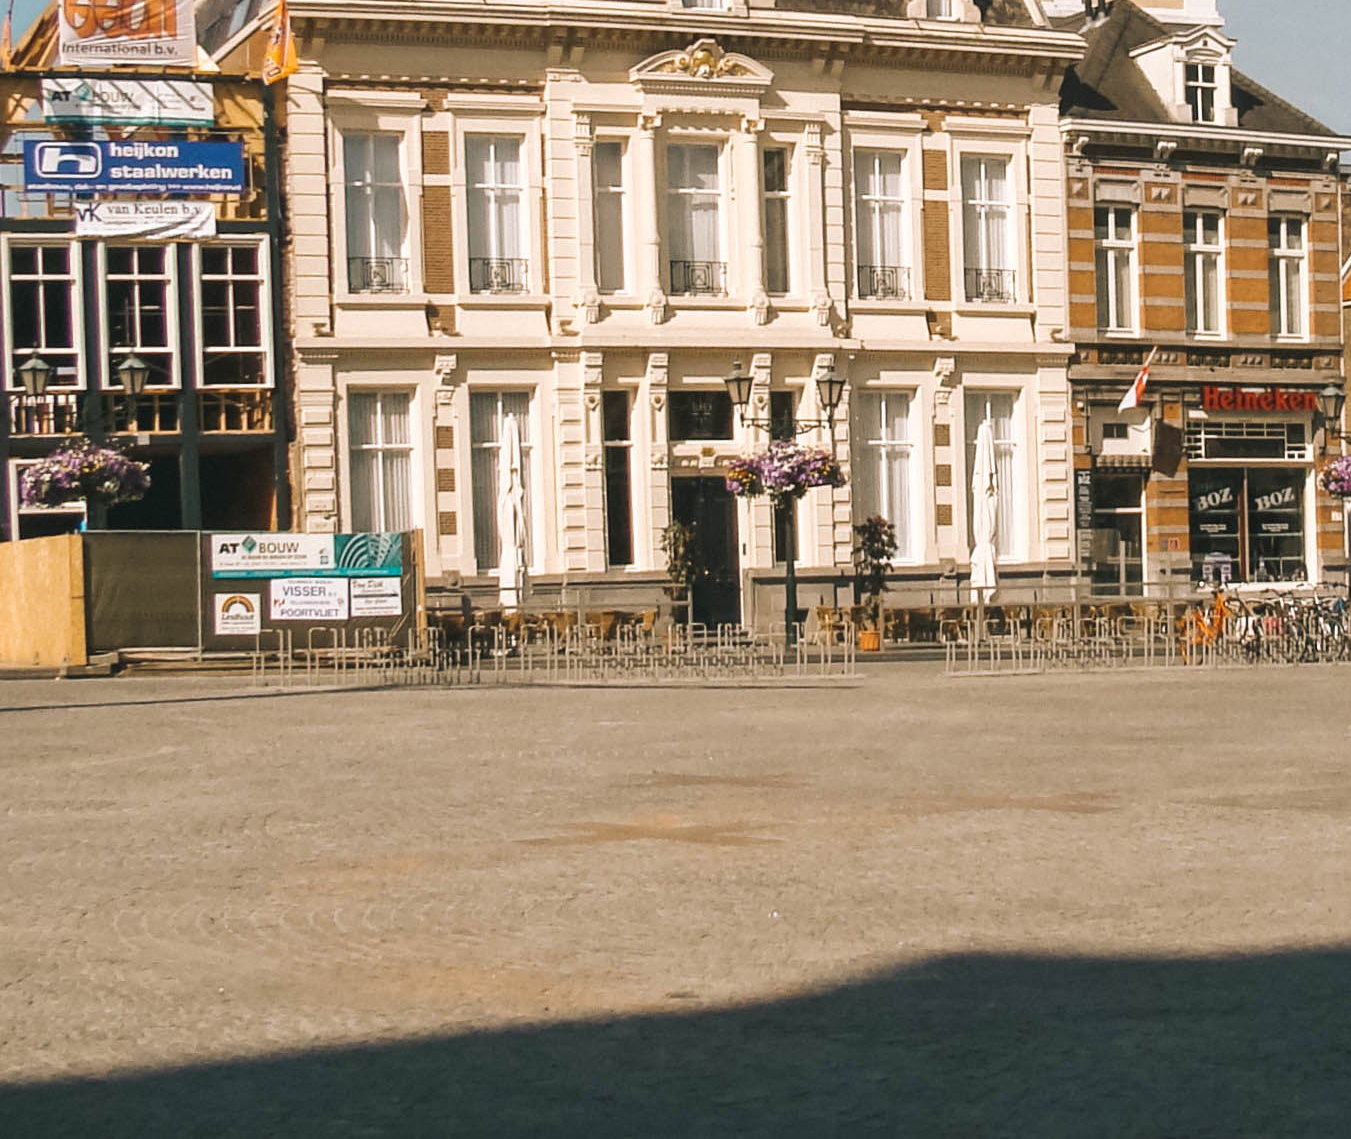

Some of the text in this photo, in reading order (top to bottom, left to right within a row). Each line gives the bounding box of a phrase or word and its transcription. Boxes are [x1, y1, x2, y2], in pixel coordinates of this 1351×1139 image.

[62, 43, 178, 56] International b.v.
[51, 90, 72, 102] AT
[109, 142, 179, 160] heijkon
[110, 164, 233, 180] staalwerken
[107, 205, 130, 215] van
[134, 203, 178, 215] Keulen
[1202, 385, 1319, 410] Heineken
[1197, 487, 1234, 511] BOZ
[1254, 487, 1295, 511] BOZ
[219, 542, 300, 554] AT BOUW
[282, 586, 327, 597] VISSER
[280, 608, 339, 618] POORTVLIET
